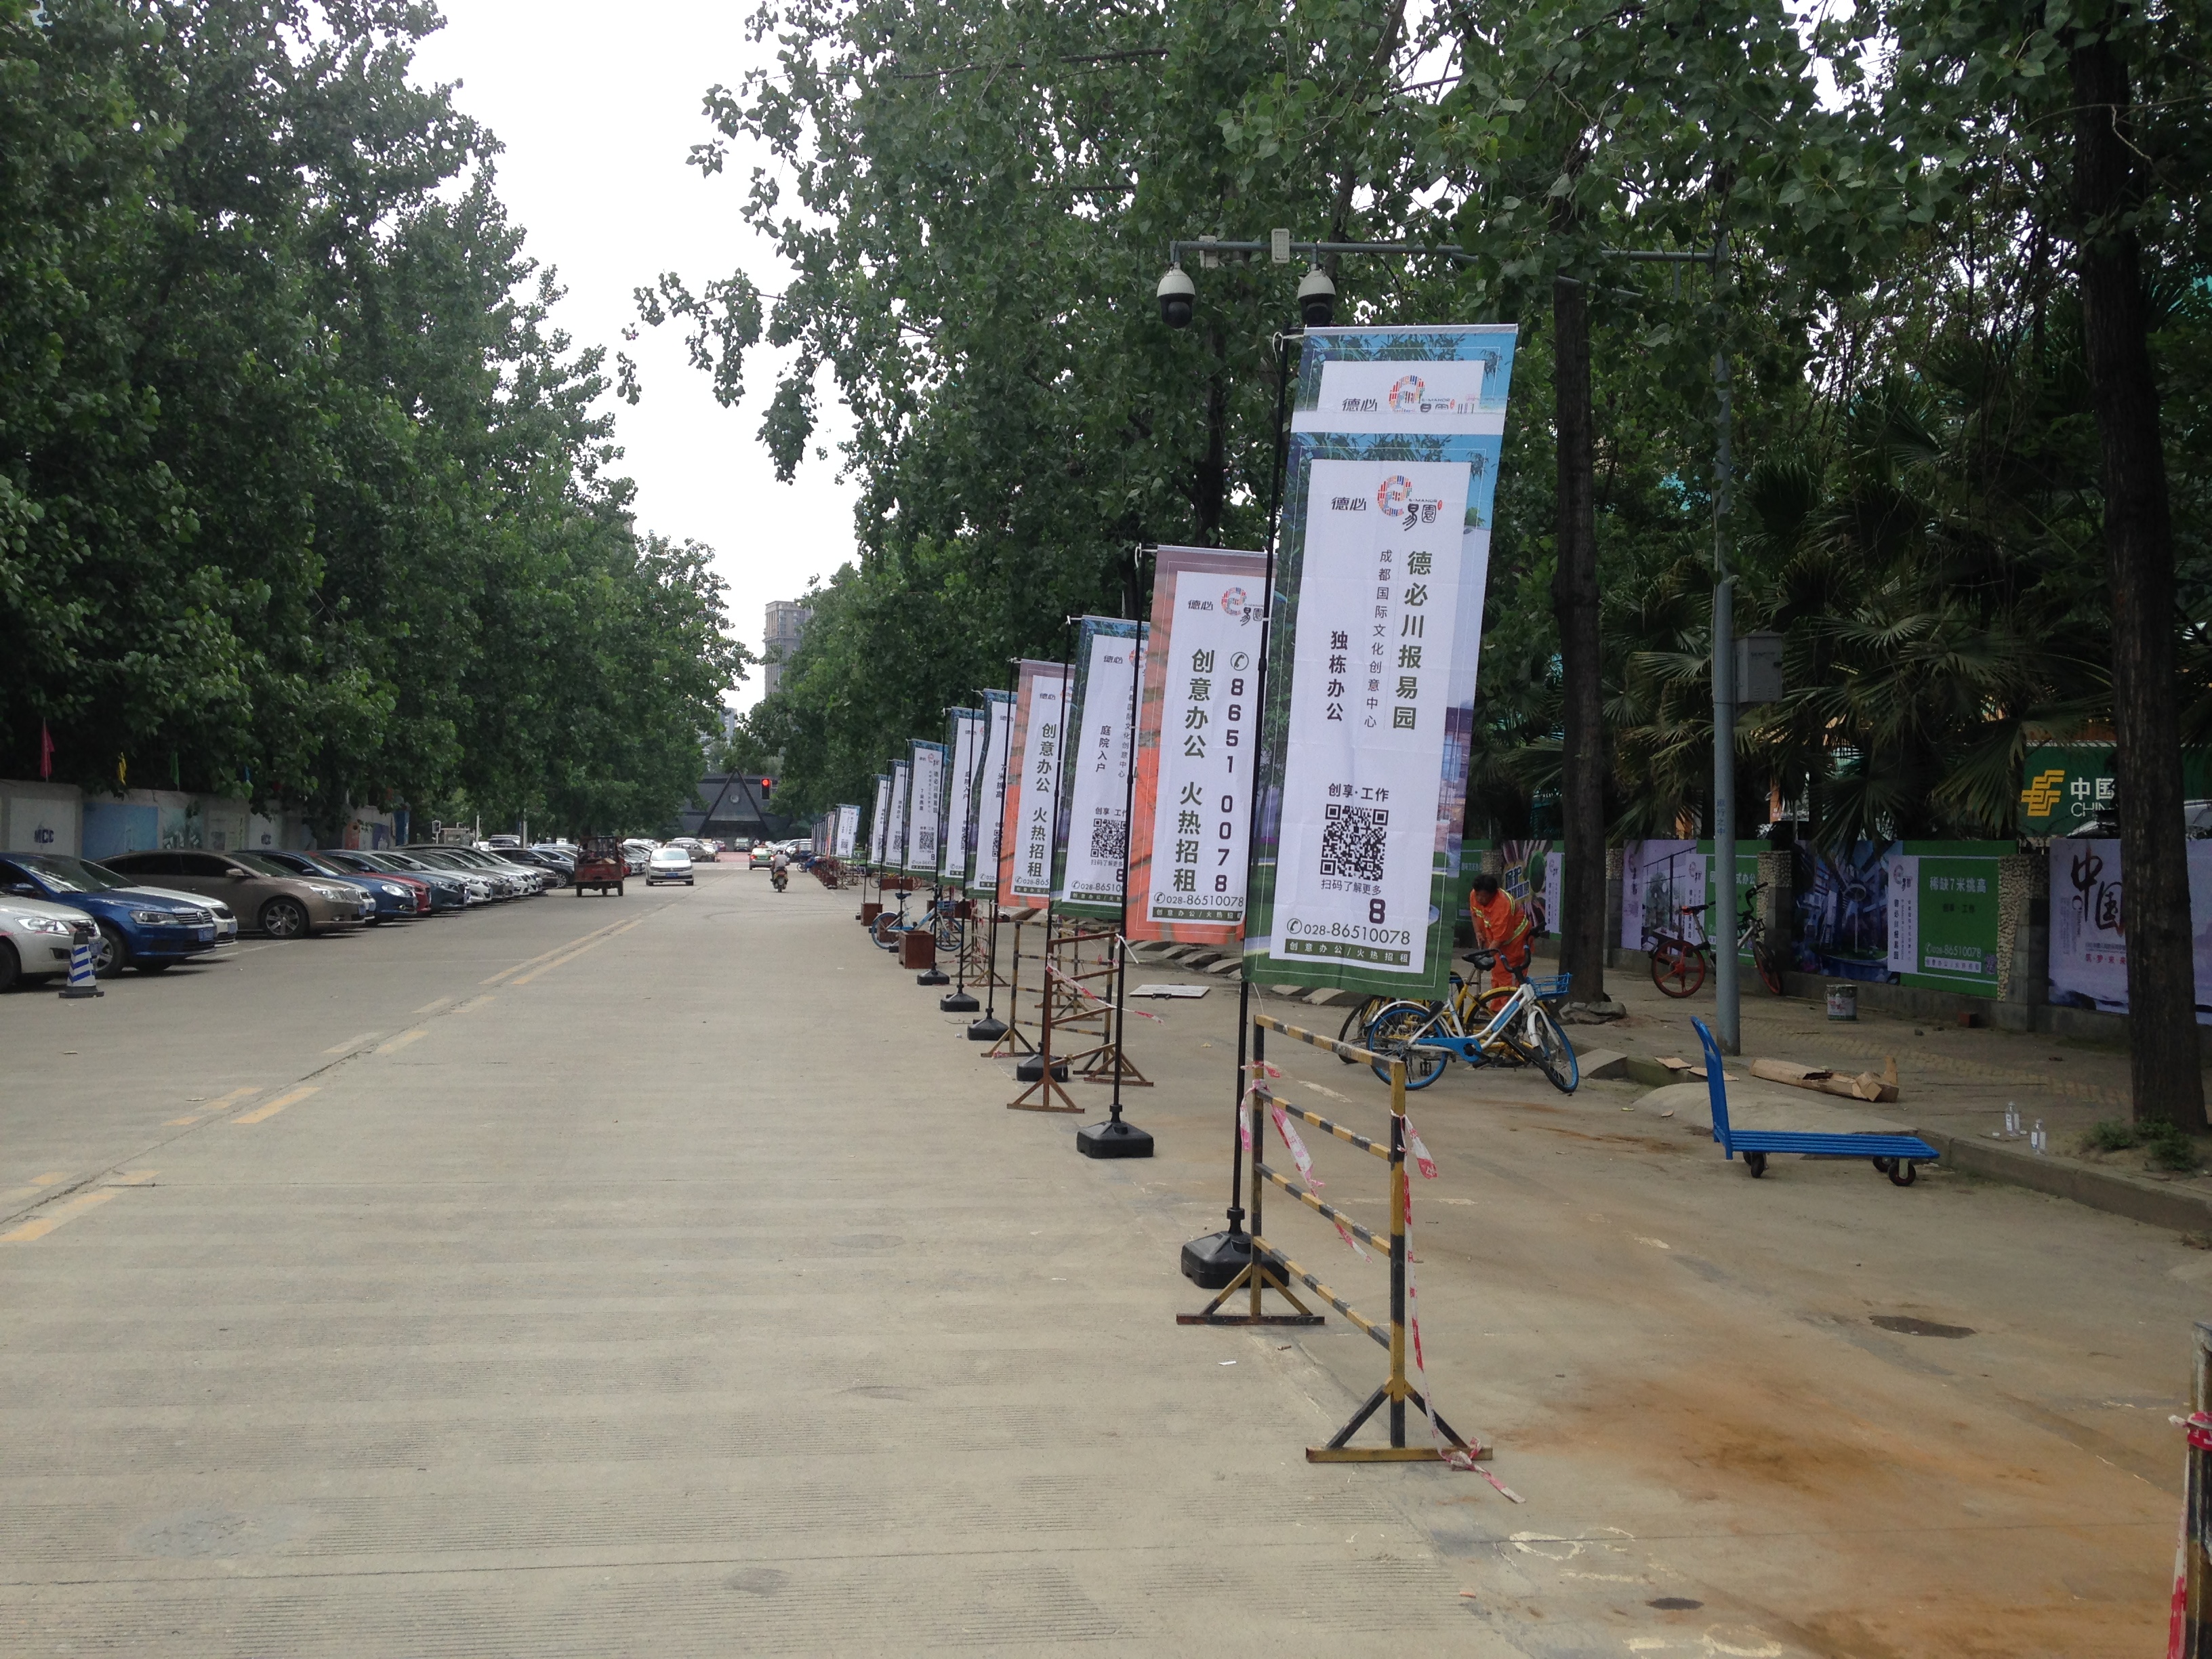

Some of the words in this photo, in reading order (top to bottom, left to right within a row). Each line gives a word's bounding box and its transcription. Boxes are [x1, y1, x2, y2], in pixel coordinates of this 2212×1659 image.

[1342, 397, 1378, 412] 德必
[1331, 496, 1367, 511] 德必
[1187, 599, 1214, 611] 德必
[1364, 549, 1393, 729] 成都国际文化创意中心
[1393, 550, 1433, 730] 德必川报易园
[1103, 655, 1123, 664] 德必
[1326, 630, 1348, 722] 独栋办公
[1183, 648, 1215, 759] 创意办公
[1036, 722, 1057, 793] 创意办公
[1095, 725, 1111, 773] 庭院入户
[1328, 783, 1390, 802] 创享·工作
[2070, 777, 2115, 800] 中国
[34, 829, 54, 843] MCC
[1027, 806, 1048, 877] 火热招租
[1172, 781, 1203, 893] 火热招租
[1321, 879, 1382, 896] 扫码了解更多
[1166, 894, 1244, 907] 028-86510078
[1369, 899, 1386, 924] 8
[1303, 922, 1410, 945] 028-86510078
[1289, 941, 1409, 963] 创意办公/火热招租
